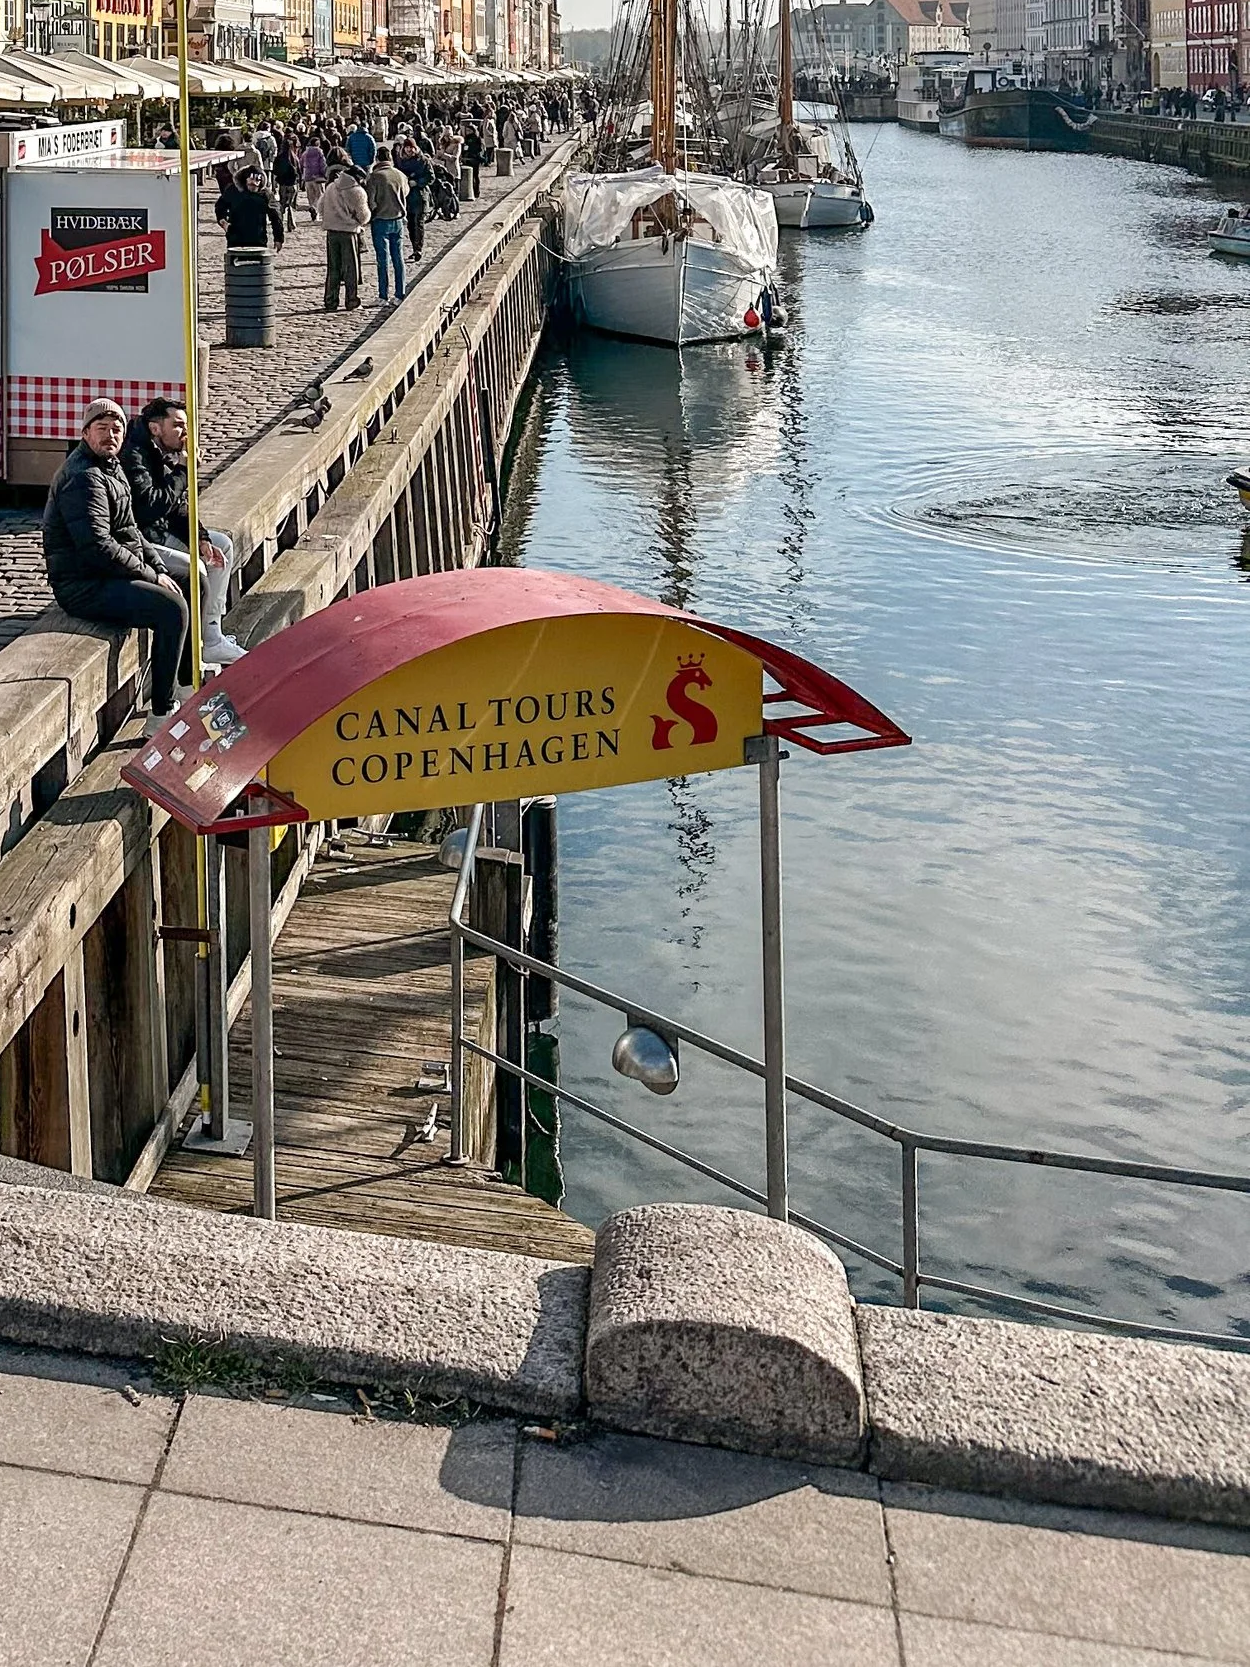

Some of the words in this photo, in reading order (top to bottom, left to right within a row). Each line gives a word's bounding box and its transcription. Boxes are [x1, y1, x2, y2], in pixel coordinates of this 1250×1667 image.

[62, 129, 103, 154] FODERBRÆT
[55, 215, 143, 230] HVIDEBÆK
[49, 242, 156, 284] PØLSER
[335, 701, 477, 742] CANAL
[488, 686, 615, 727] TOURS
[331, 728, 621, 787] COPENHAGEN
